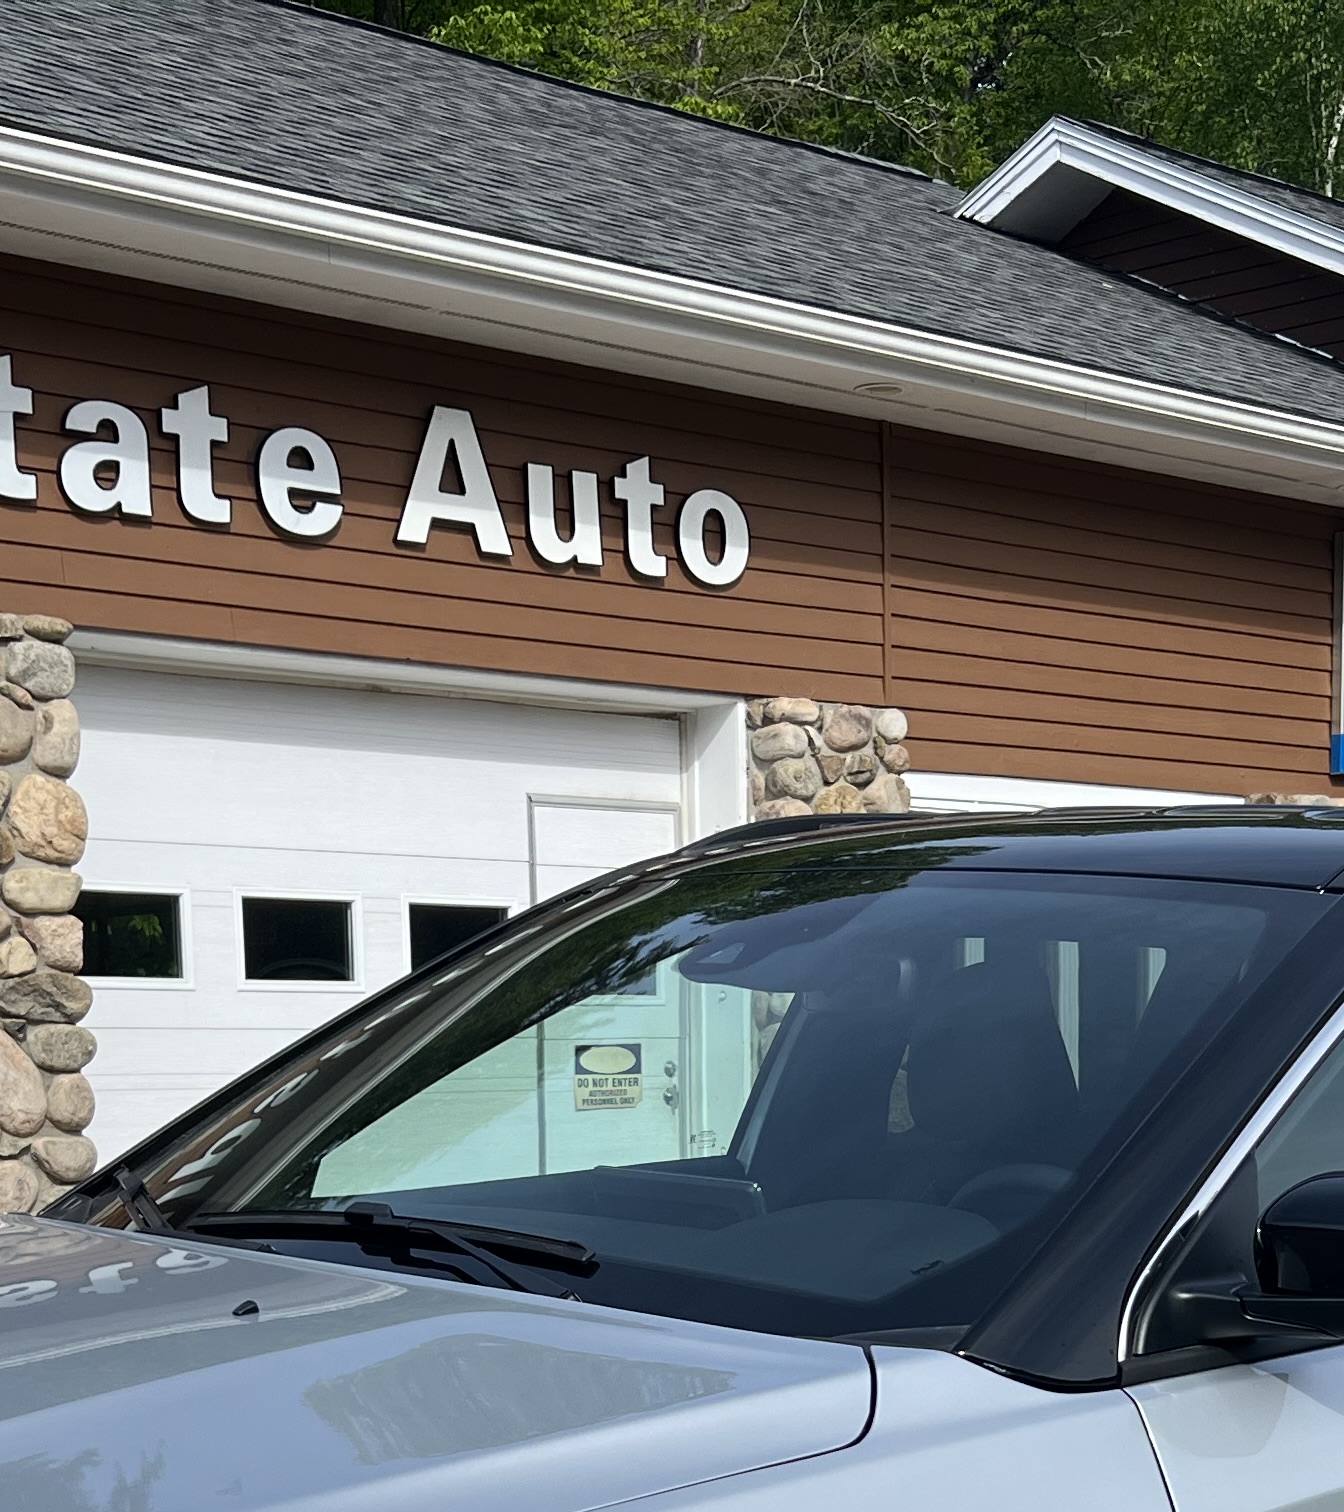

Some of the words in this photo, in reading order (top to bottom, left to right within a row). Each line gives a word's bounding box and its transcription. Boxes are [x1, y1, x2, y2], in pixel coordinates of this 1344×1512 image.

[394, 403, 752, 587] Auto
[577, 1078, 589, 1088] DO
[592, 1077, 609, 1088] NOT
[612, 1077, 639, 1088] ENTER
